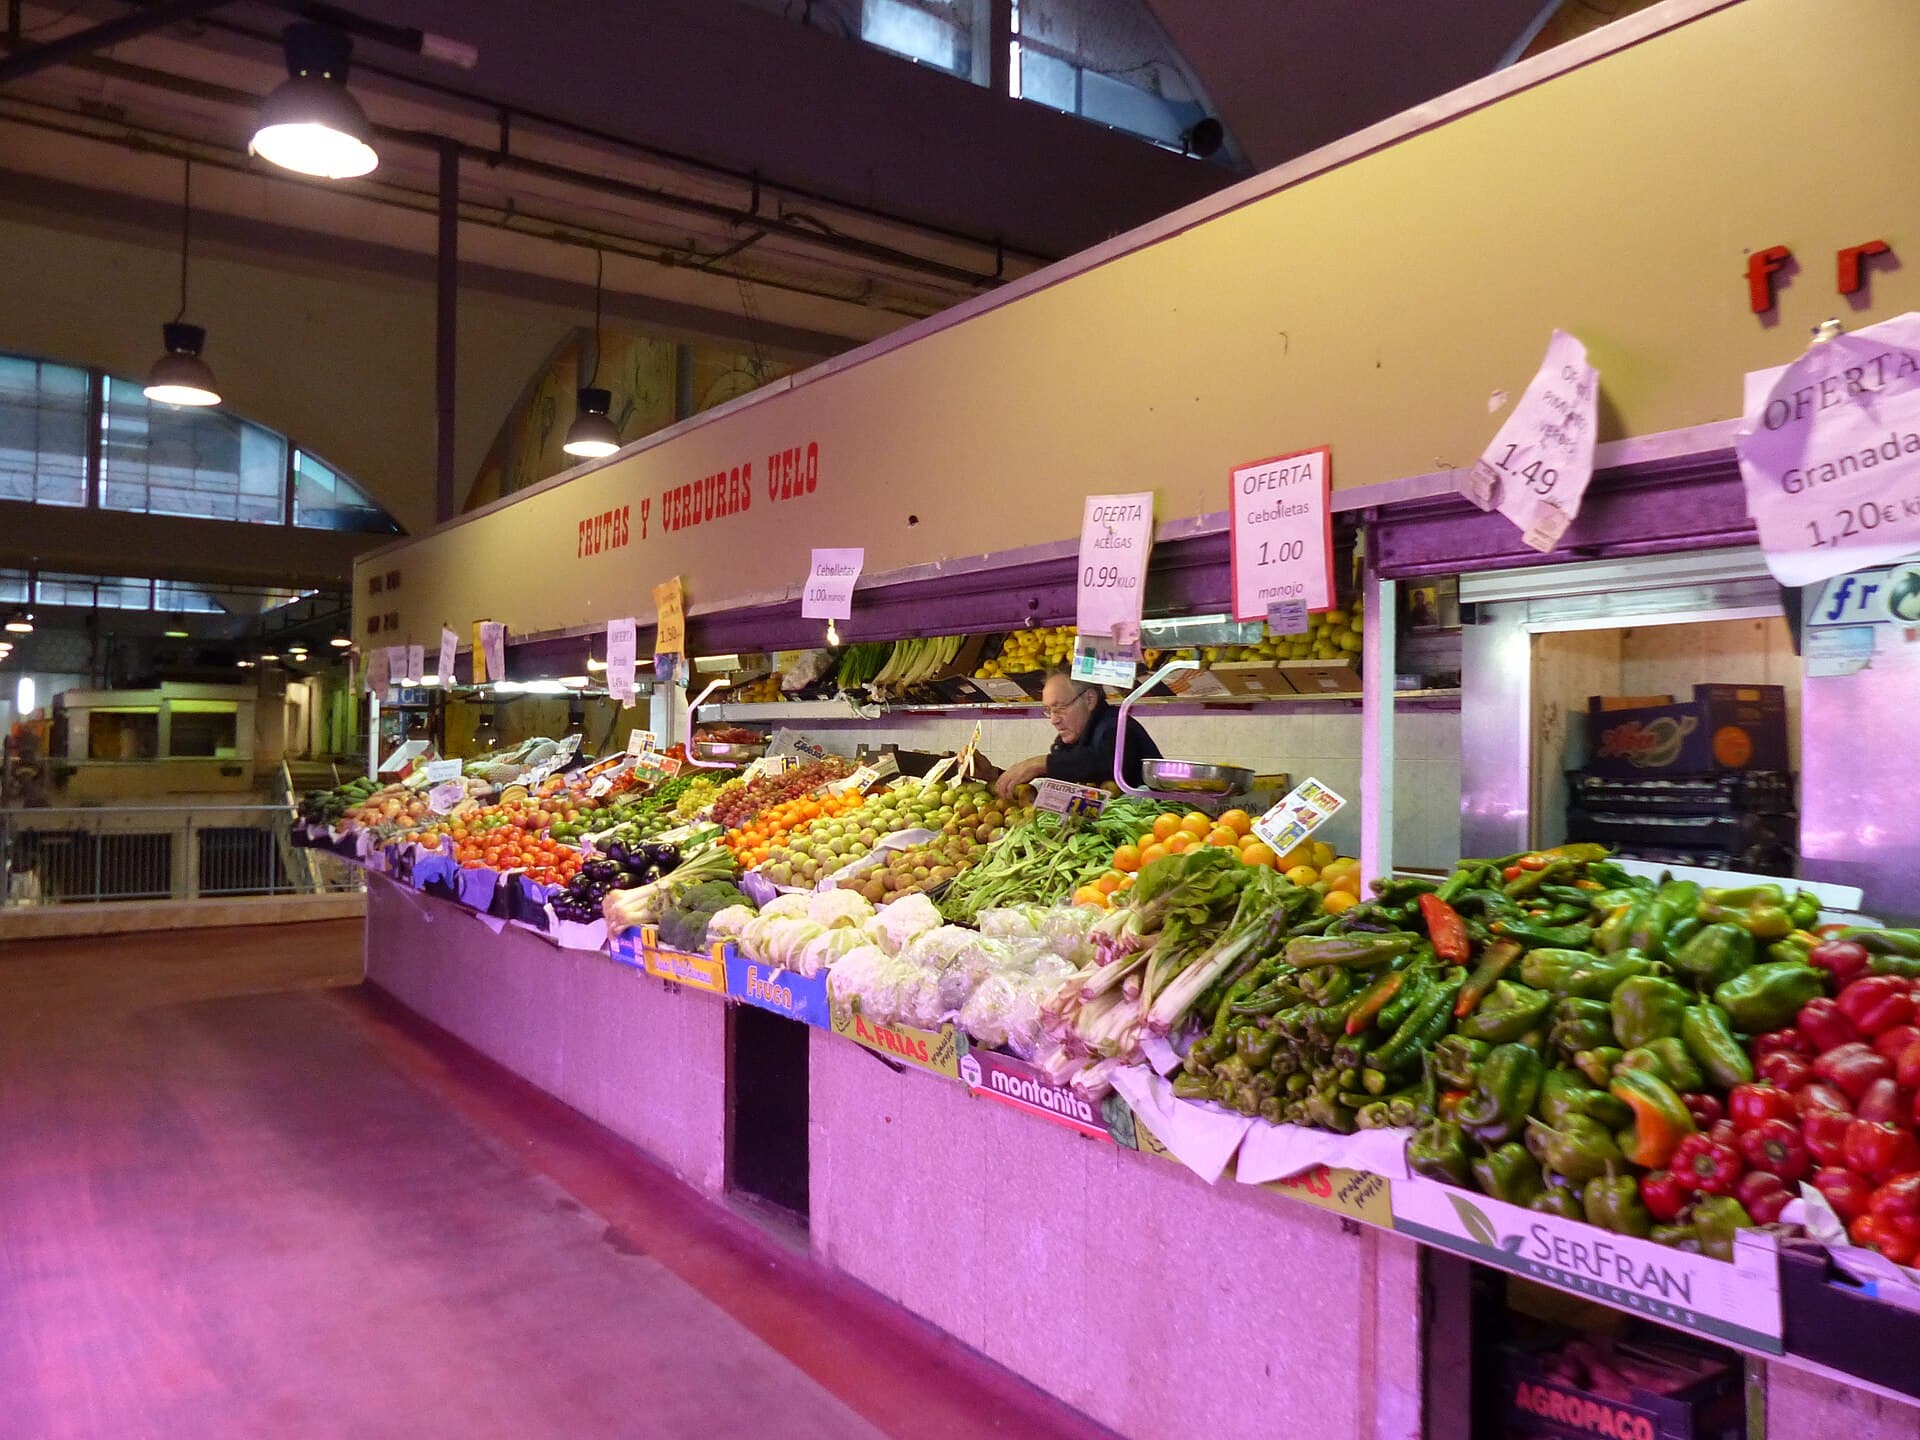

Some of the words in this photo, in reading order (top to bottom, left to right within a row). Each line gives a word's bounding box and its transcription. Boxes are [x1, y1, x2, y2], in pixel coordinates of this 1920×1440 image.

[1764, 352, 1920, 431] OFERTA
[1243, 463, 1312, 495] OFERTA
[1496, 444, 1558, 495] 1.49
[578, 505, 630, 559] FRUTAS
[641, 497, 651, 540] Y
[662, 462, 751, 534] VERDURAS
[768, 441, 818, 502] VELO
[1092, 505, 1142, 523] OFERTA
[1247, 502, 1310, 524] Cebolletas
[1094, 537, 1132, 549] ACELGAS
[1257, 540, 1304, 566] 1.00
[816, 564, 855, 577] Cebolletas
[1258, 581, 1303, 599] manojo
[1046, 781, 1077, 794] FRUTAS
[855, 1014, 873, 1043] A.
[875, 1023, 929, 1063] FRIAS
[991, 1068, 1093, 1123] montañita
[1515, 1380, 1654, 1440] AGROPACO
